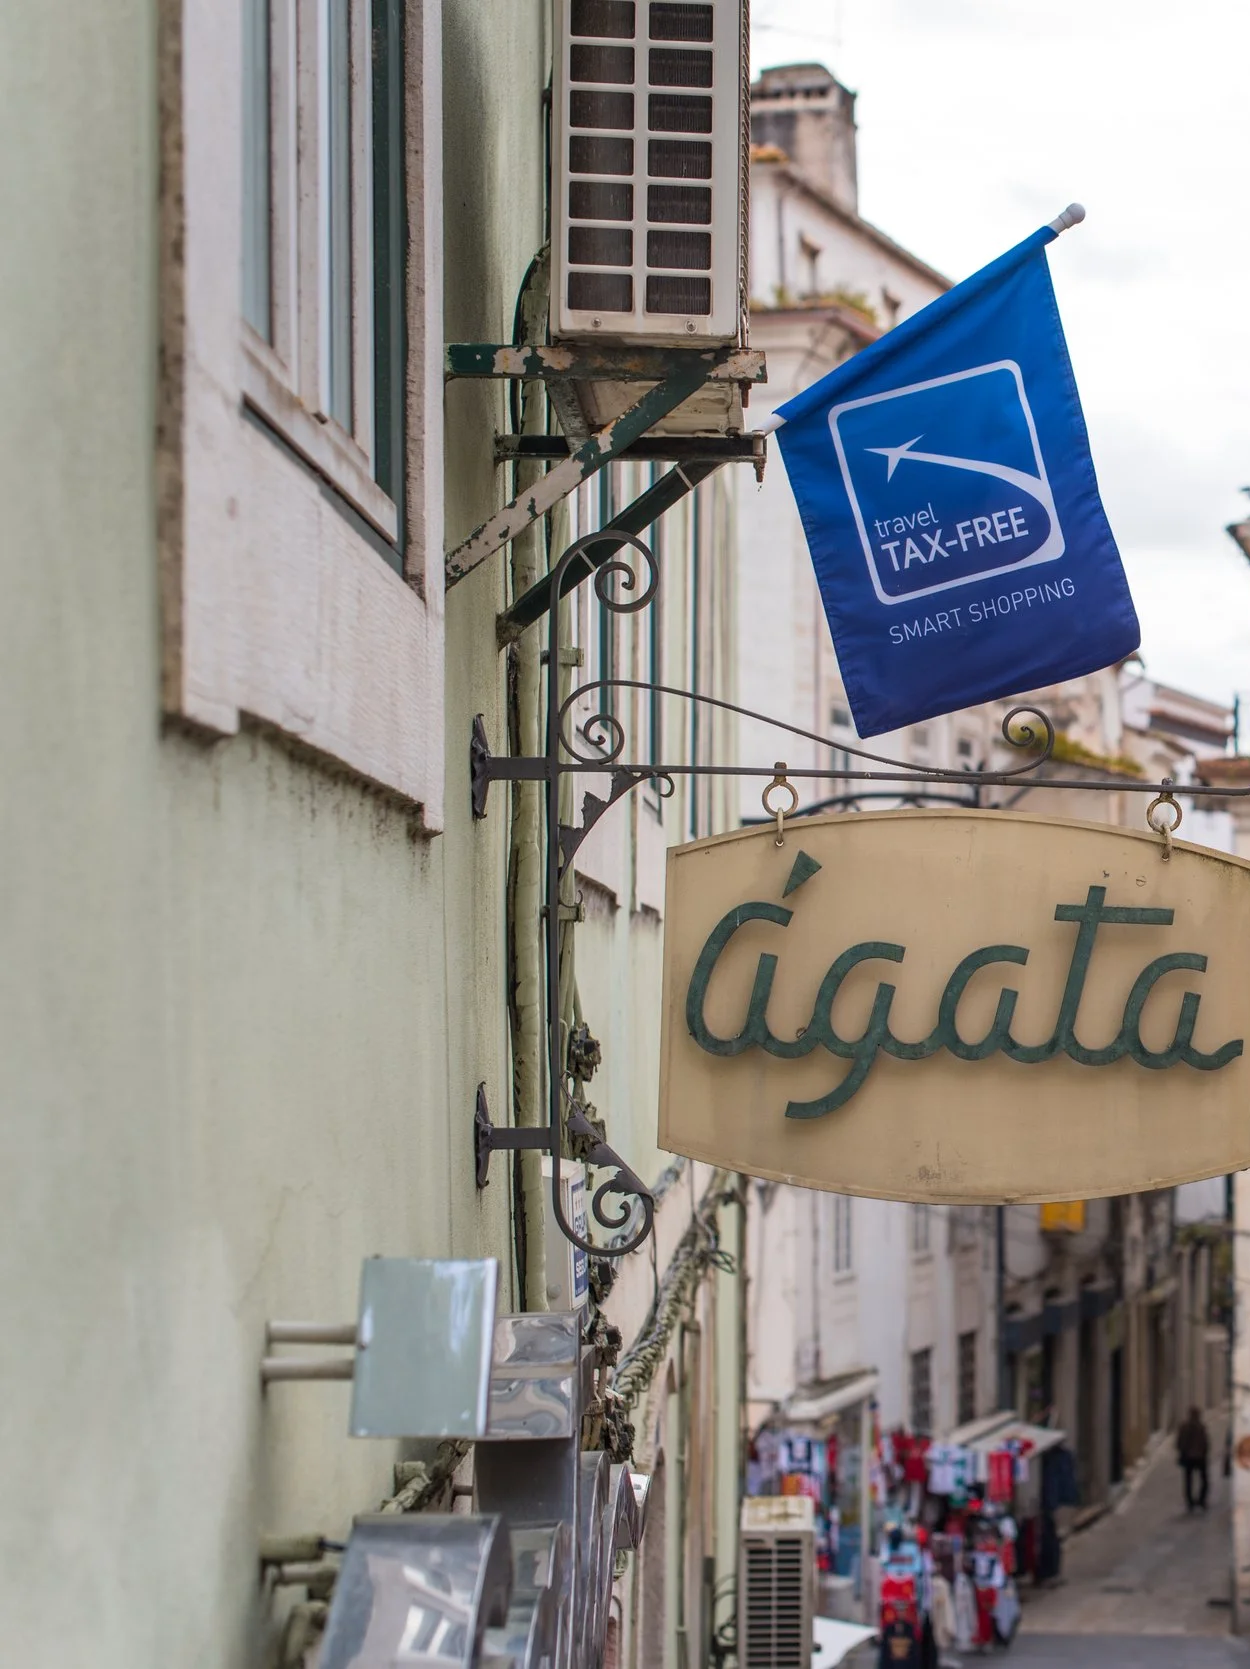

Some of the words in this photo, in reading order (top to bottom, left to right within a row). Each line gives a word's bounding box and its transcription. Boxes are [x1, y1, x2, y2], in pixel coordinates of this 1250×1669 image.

[874, 502, 939, 538] travel
[880, 506, 1029, 572] TAX-FREE
[889, 607, 962, 645] SMART
[968, 577, 1075, 622] SHOPPING
